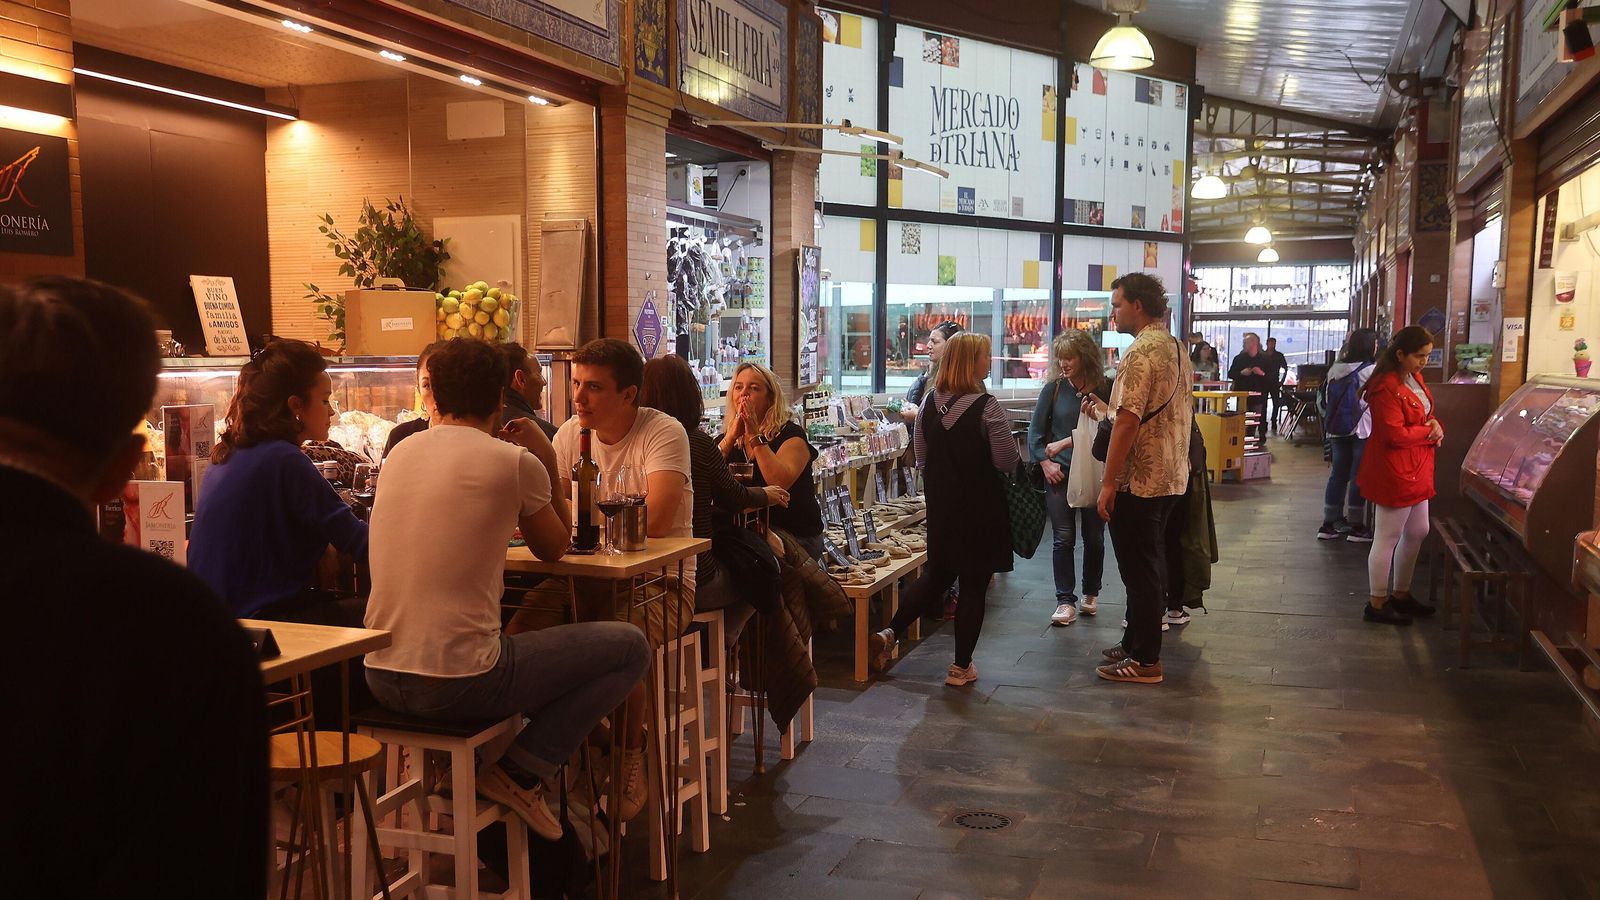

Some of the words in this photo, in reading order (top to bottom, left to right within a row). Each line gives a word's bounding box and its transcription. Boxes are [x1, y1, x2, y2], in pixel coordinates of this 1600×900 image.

[930, 85, 1020, 136] MERCADO
[941, 131, 1021, 172] TRIANA
[206, 293, 228, 301] VINO
[206, 311, 237, 319] familia
